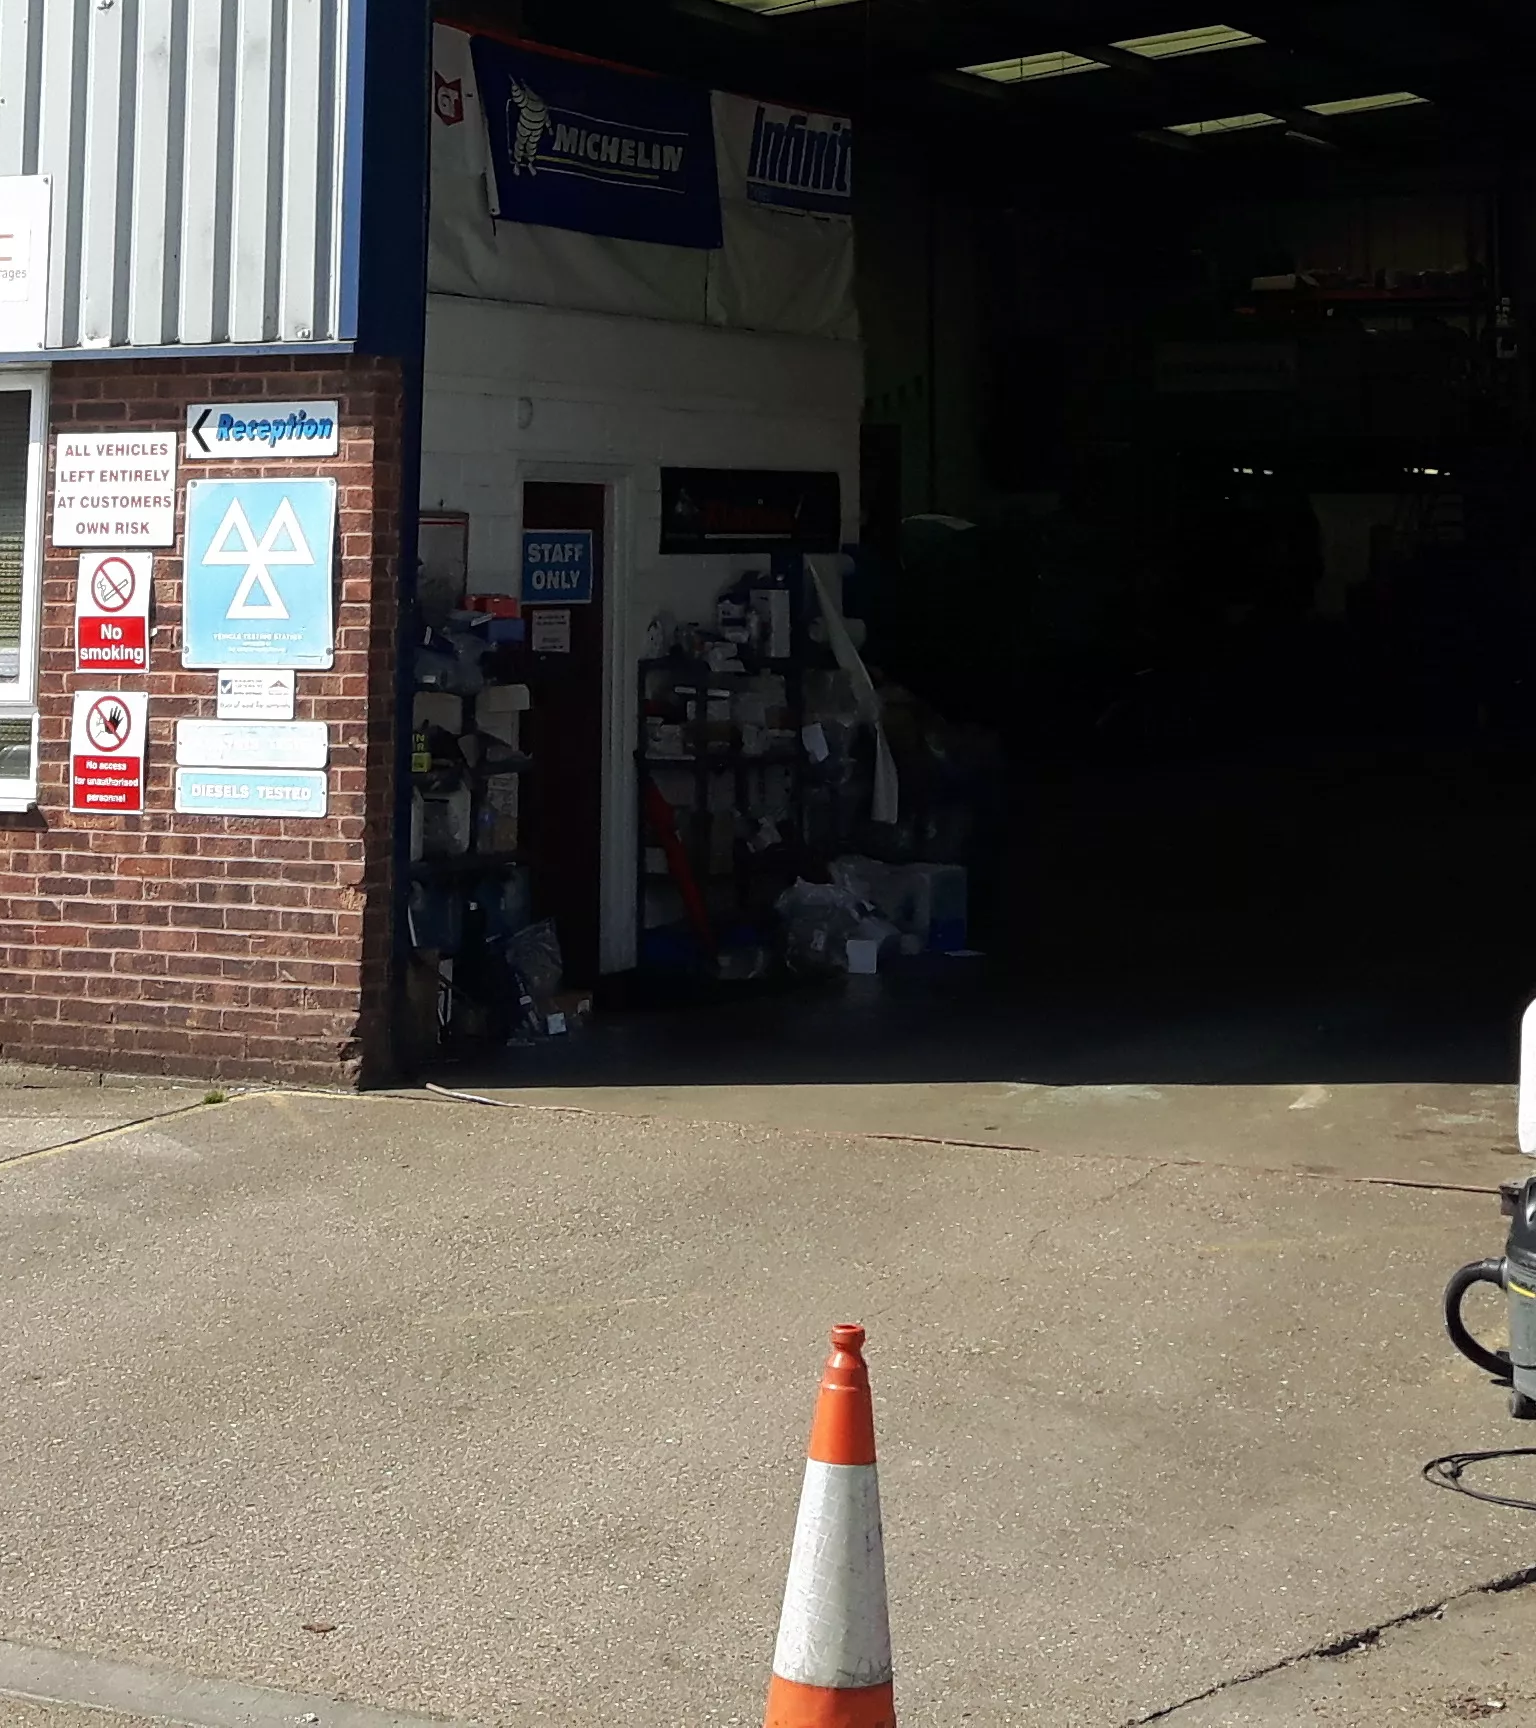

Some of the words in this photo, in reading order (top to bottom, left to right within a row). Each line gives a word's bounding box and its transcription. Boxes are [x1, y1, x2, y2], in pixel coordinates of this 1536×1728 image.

[552, 123, 684, 172] MICHELIN
[215, 409, 334, 448] Reception
[65, 445, 92, 457] ALL
[96, 443, 169, 457] VEHICLES
[60, 469, 96, 483] LEFT
[99, 469, 170, 483] ENTIRELY
[57, 496, 76, 509] AT
[79, 495, 173, 509] CUSTOMERS
[75, 521, 110, 535] OWN
[115, 521, 151, 535] RISK
[528, 543, 584, 564] STAFF
[532, 570, 581, 590] ONLY
[100, 623, 123, 641] No
[79, 645, 144, 665] smoking
[86, 760, 98, 770] No
[191, 783, 250, 799] DIESELS
[256, 785, 312, 801] TESTED
